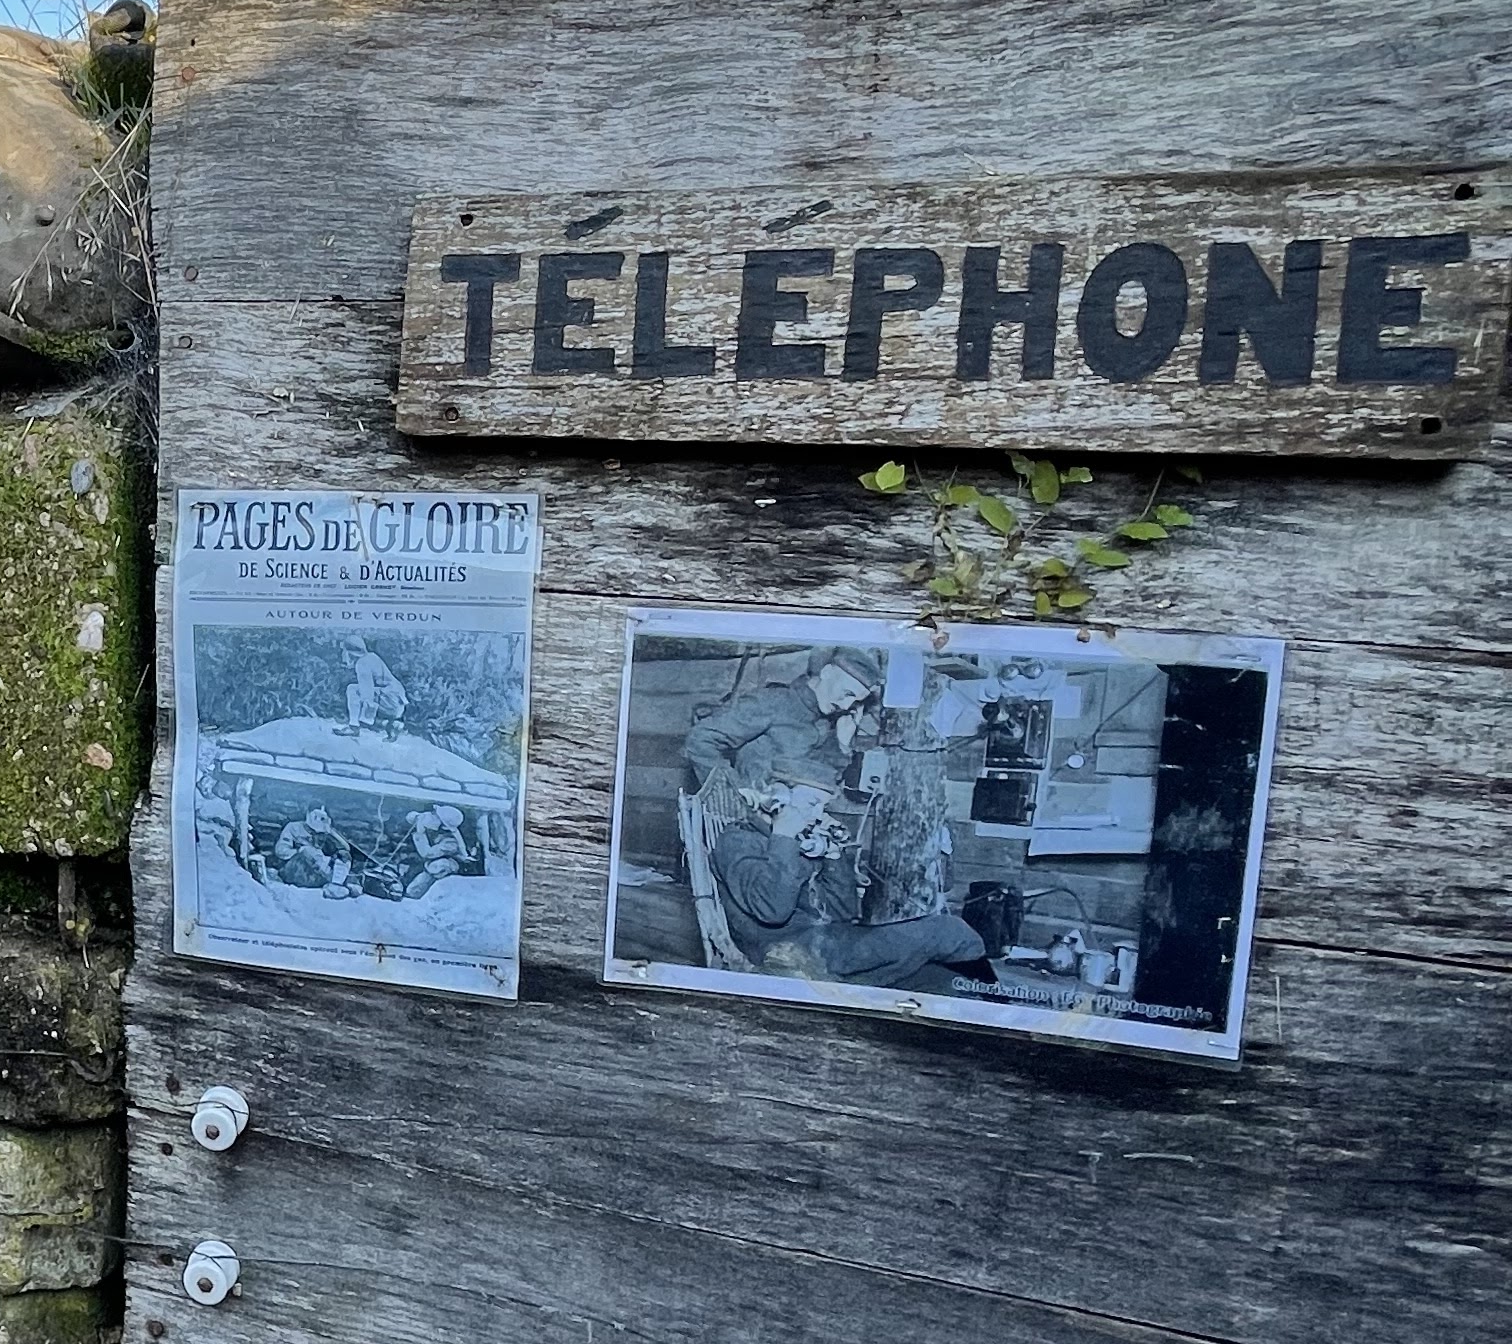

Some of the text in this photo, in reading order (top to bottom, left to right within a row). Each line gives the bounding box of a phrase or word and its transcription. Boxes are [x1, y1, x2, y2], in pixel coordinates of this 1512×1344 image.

[441, 200, 1470, 386] TÉLÉPHONE
[190, 501, 529, 555] PAGES DE GLOIRE
[239, 562, 258, 578] DE
[265, 558, 328, 580] SCIENCE
[339, 566, 351, 581] &
[265, 610, 442, 623] AUTOUR DE VERDUN
